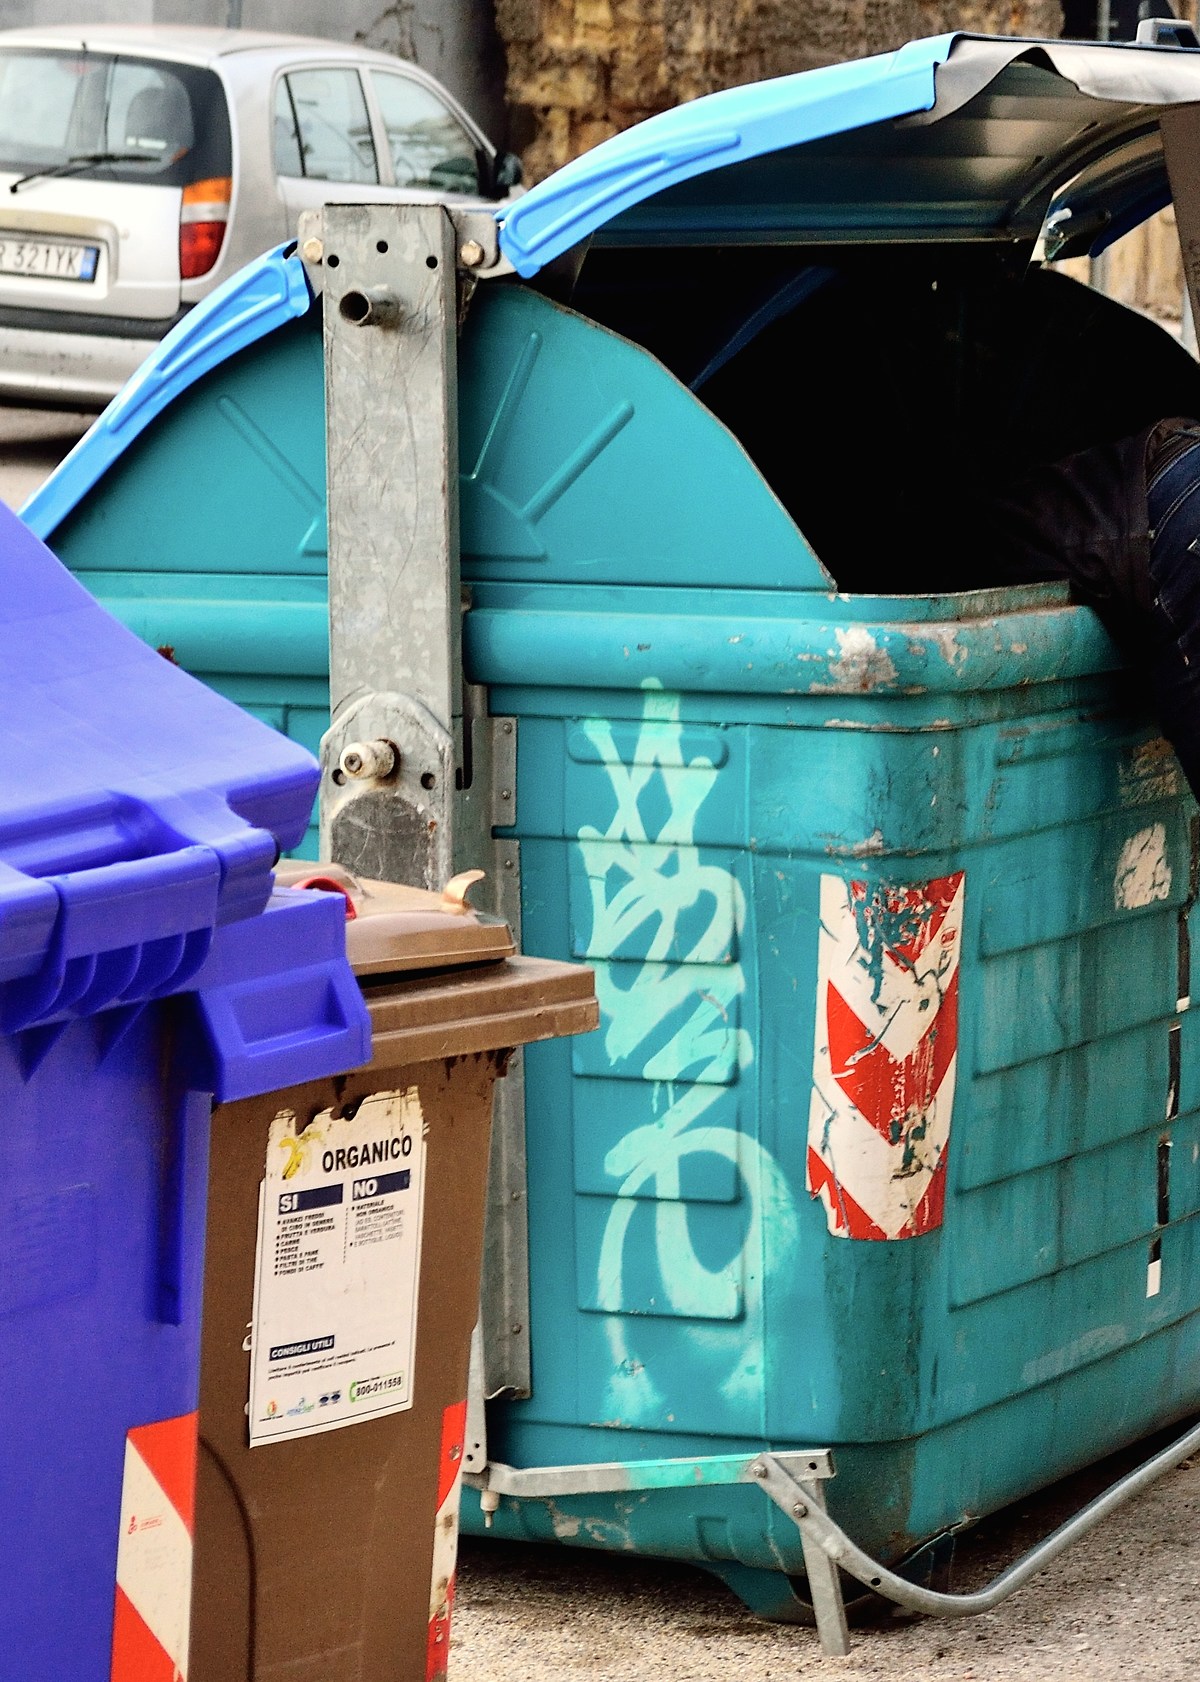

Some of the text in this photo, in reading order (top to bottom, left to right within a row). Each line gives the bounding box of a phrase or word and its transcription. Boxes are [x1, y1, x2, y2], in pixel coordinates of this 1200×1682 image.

[14, 244, 80, 273] 321YK
[322, 1134, 412, 1174] ORGANICO
[353, 1178, 378, 1199] NO
[280, 1194, 299, 1213] SI
[289, 1223, 303, 1231] CIBO
[280, 1238, 300, 1247] CARNE
[280, 1246, 298, 1254] PESCE
[280, 1253, 298, 1261] PASTA
[271, 1337, 334, 1358] CONSIGLI UTILI
[356, 1376, 402, 1397] 800-011558
